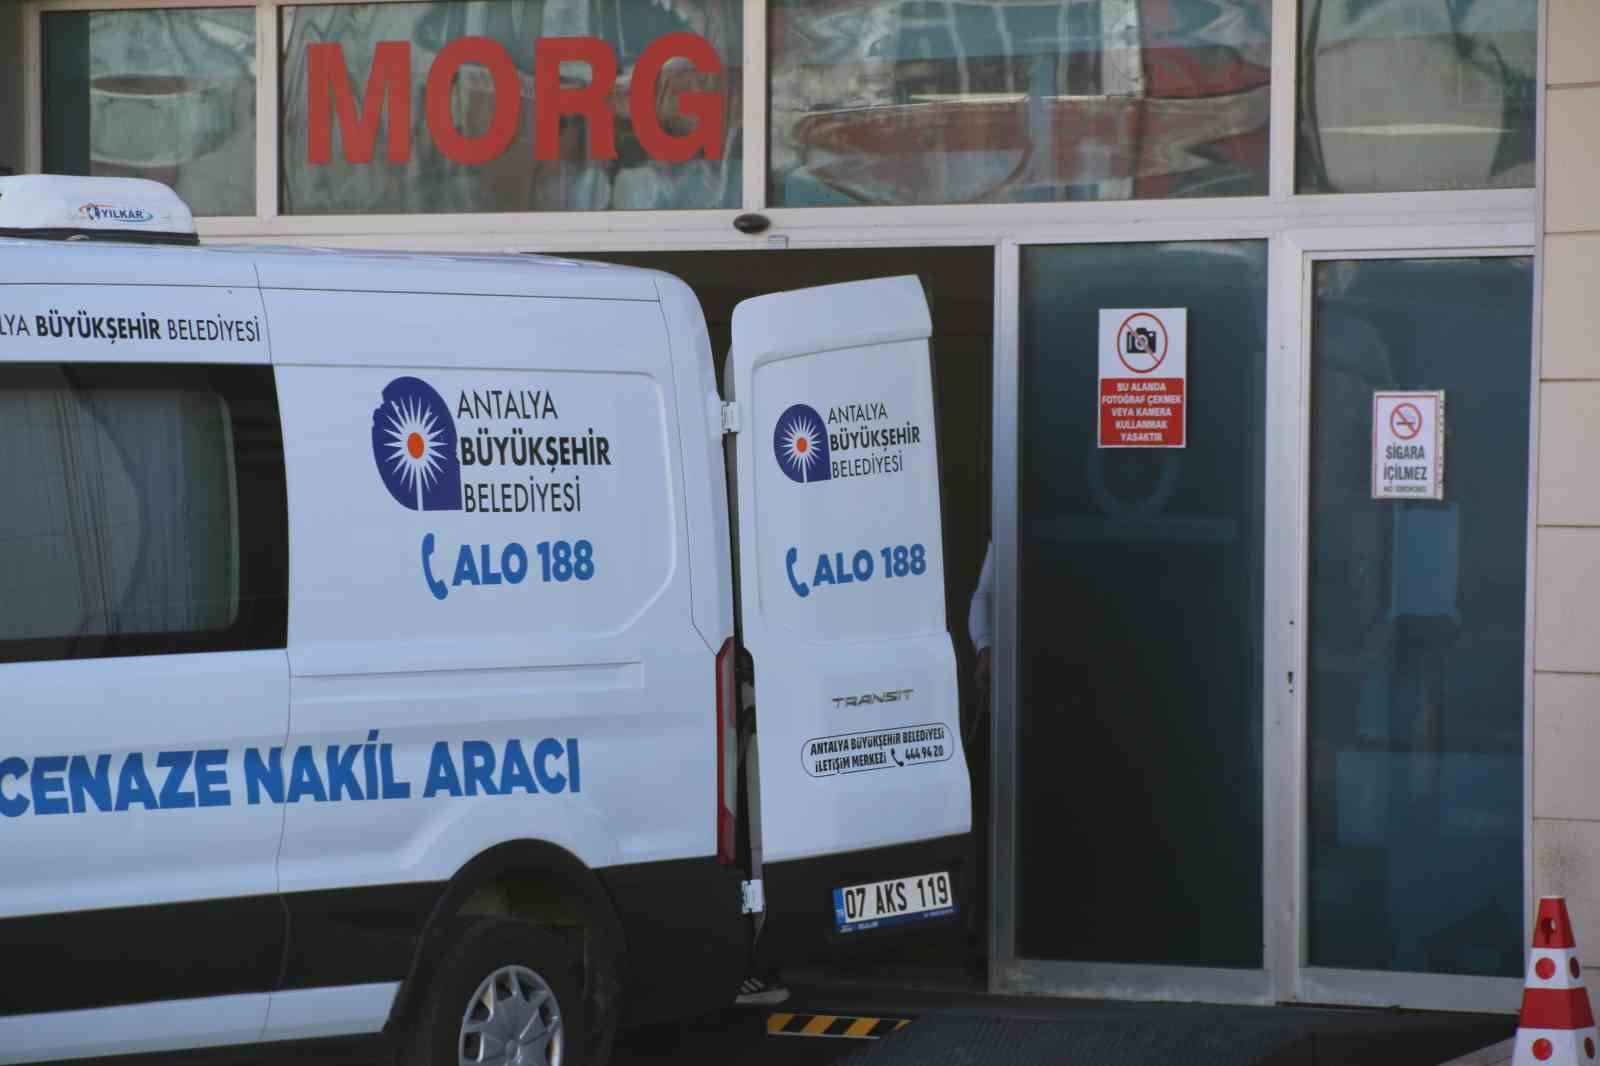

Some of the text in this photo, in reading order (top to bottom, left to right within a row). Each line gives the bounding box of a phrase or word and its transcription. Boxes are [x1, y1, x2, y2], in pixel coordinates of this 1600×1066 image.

[307, 32, 724, 166] MORG
[101, 208, 145, 219] YILKAR
[35, 309, 161, 345] BÜYÜKŞEHİR
[167, 313, 261, 342] BELEDİYESİ
[1116, 382, 1167, 392] BU ALANDA
[457, 390, 558, 419] ANTALYA
[828, 402, 888, 424] ANTALYA
[1111, 407, 1172, 417] VEYA KAMERA
[460, 428, 612, 473] BÜYÜKŞEHİR
[829, 421, 920, 452] BÜYÜKŞEHİR
[832, 450, 904, 479] BELEDİYESİ
[1385, 443, 1425, 460] SİGARA
[1383, 463, 1428, 483] İÇİLMEZ
[464, 475, 581, 513] BELEDİYESİ
[452, 540, 595, 586] ALO 188
[813, 543, 926, 586] ALO 188
[832, 688, 915, 709] TRANSIT
[810, 727, 945, 756] ANTALYA BÜYÜKŞEHİR BELEDİYESİ
[905, 744, 944, 761] 444 94 20
[0, 729, 581, 818] CENAZE NAKİL ARACI
[815, 751, 887, 774] İLETİŞİM MERKEZİ
[845, 875, 949, 919] 07 AKS 119
